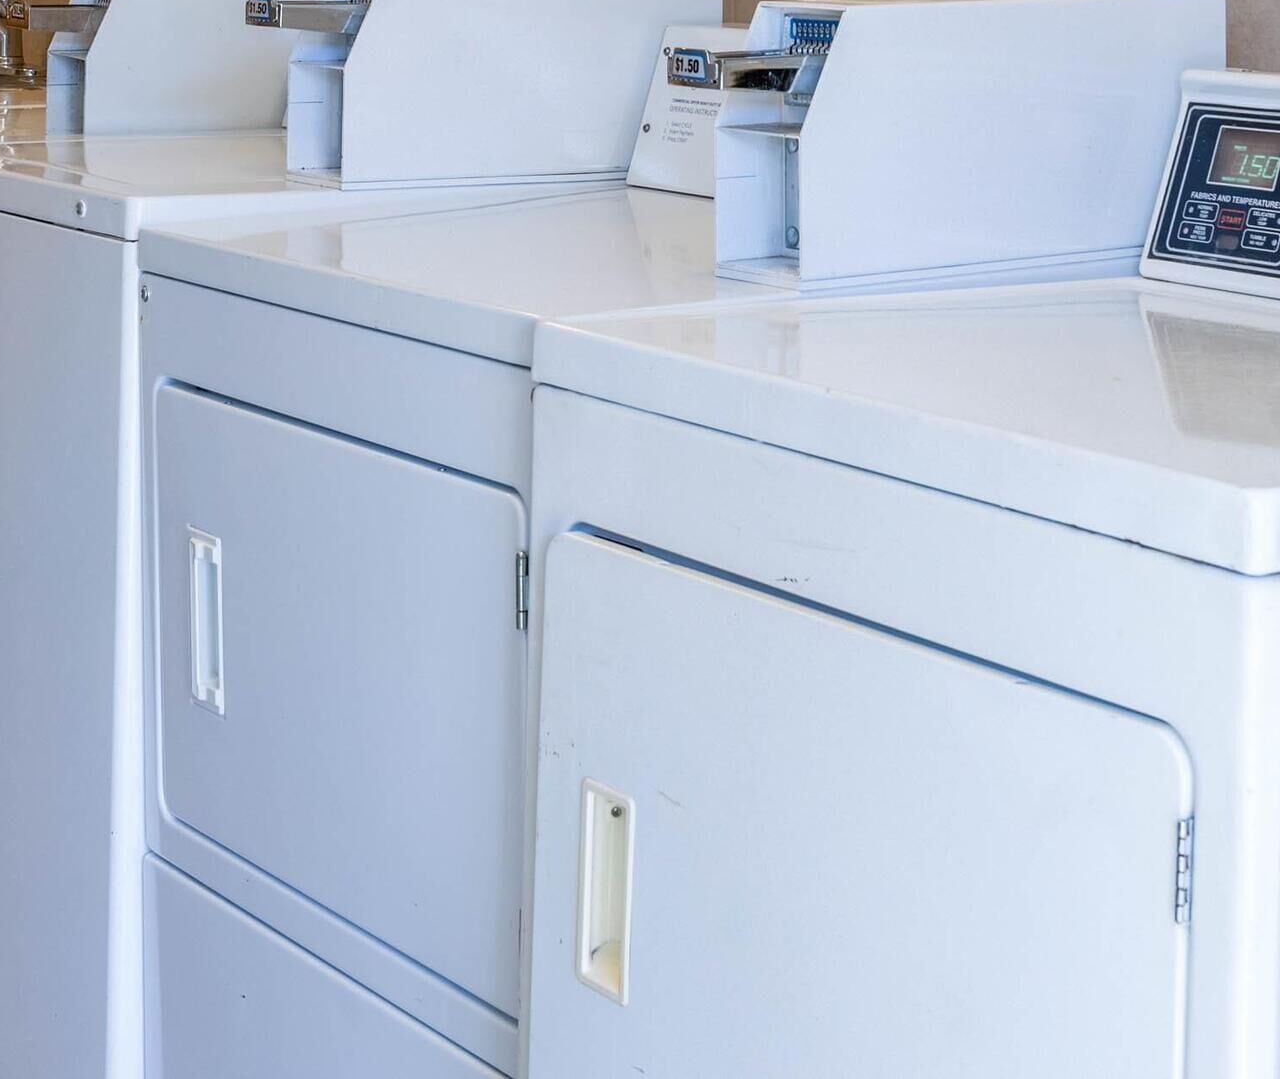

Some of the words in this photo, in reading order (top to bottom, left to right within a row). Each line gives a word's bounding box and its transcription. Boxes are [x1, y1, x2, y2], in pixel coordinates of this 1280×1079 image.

[675, 57, 699, 73] $1.50
[1190, 191, 1217, 201] FABRICS
[1217, 194, 1232, 203] AND
[1220, 214, 1242, 224] START
